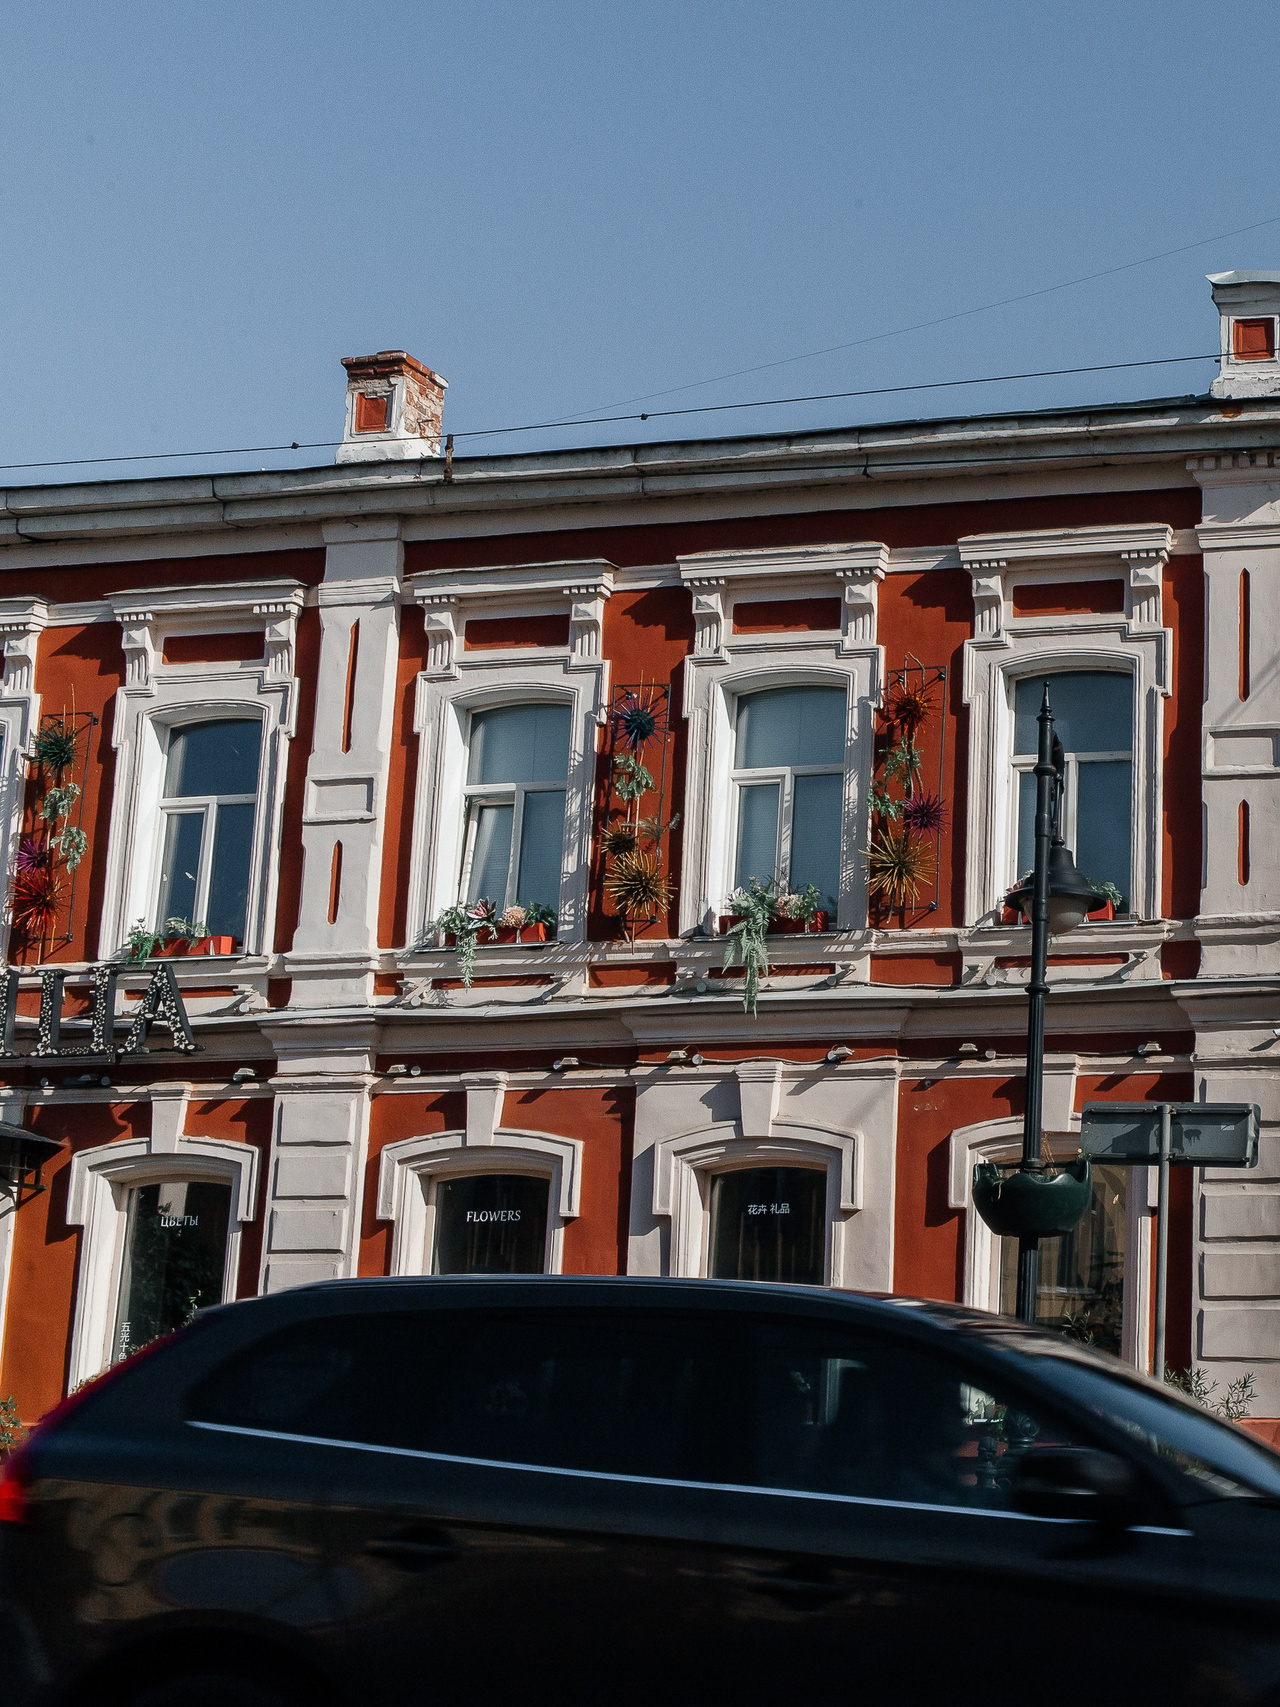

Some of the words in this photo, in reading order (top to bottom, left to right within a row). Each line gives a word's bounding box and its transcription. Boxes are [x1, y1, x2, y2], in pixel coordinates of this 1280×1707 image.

[747, 1203, 768, 1215] 花卉
[769, 1202, 791, 1215] 礼品
[160, 1215, 199, 1228] ЦВЕТЫ
[466, 1209, 521, 1223] FLOWERS
[118, 1321, 131, 1363] 五光十色
